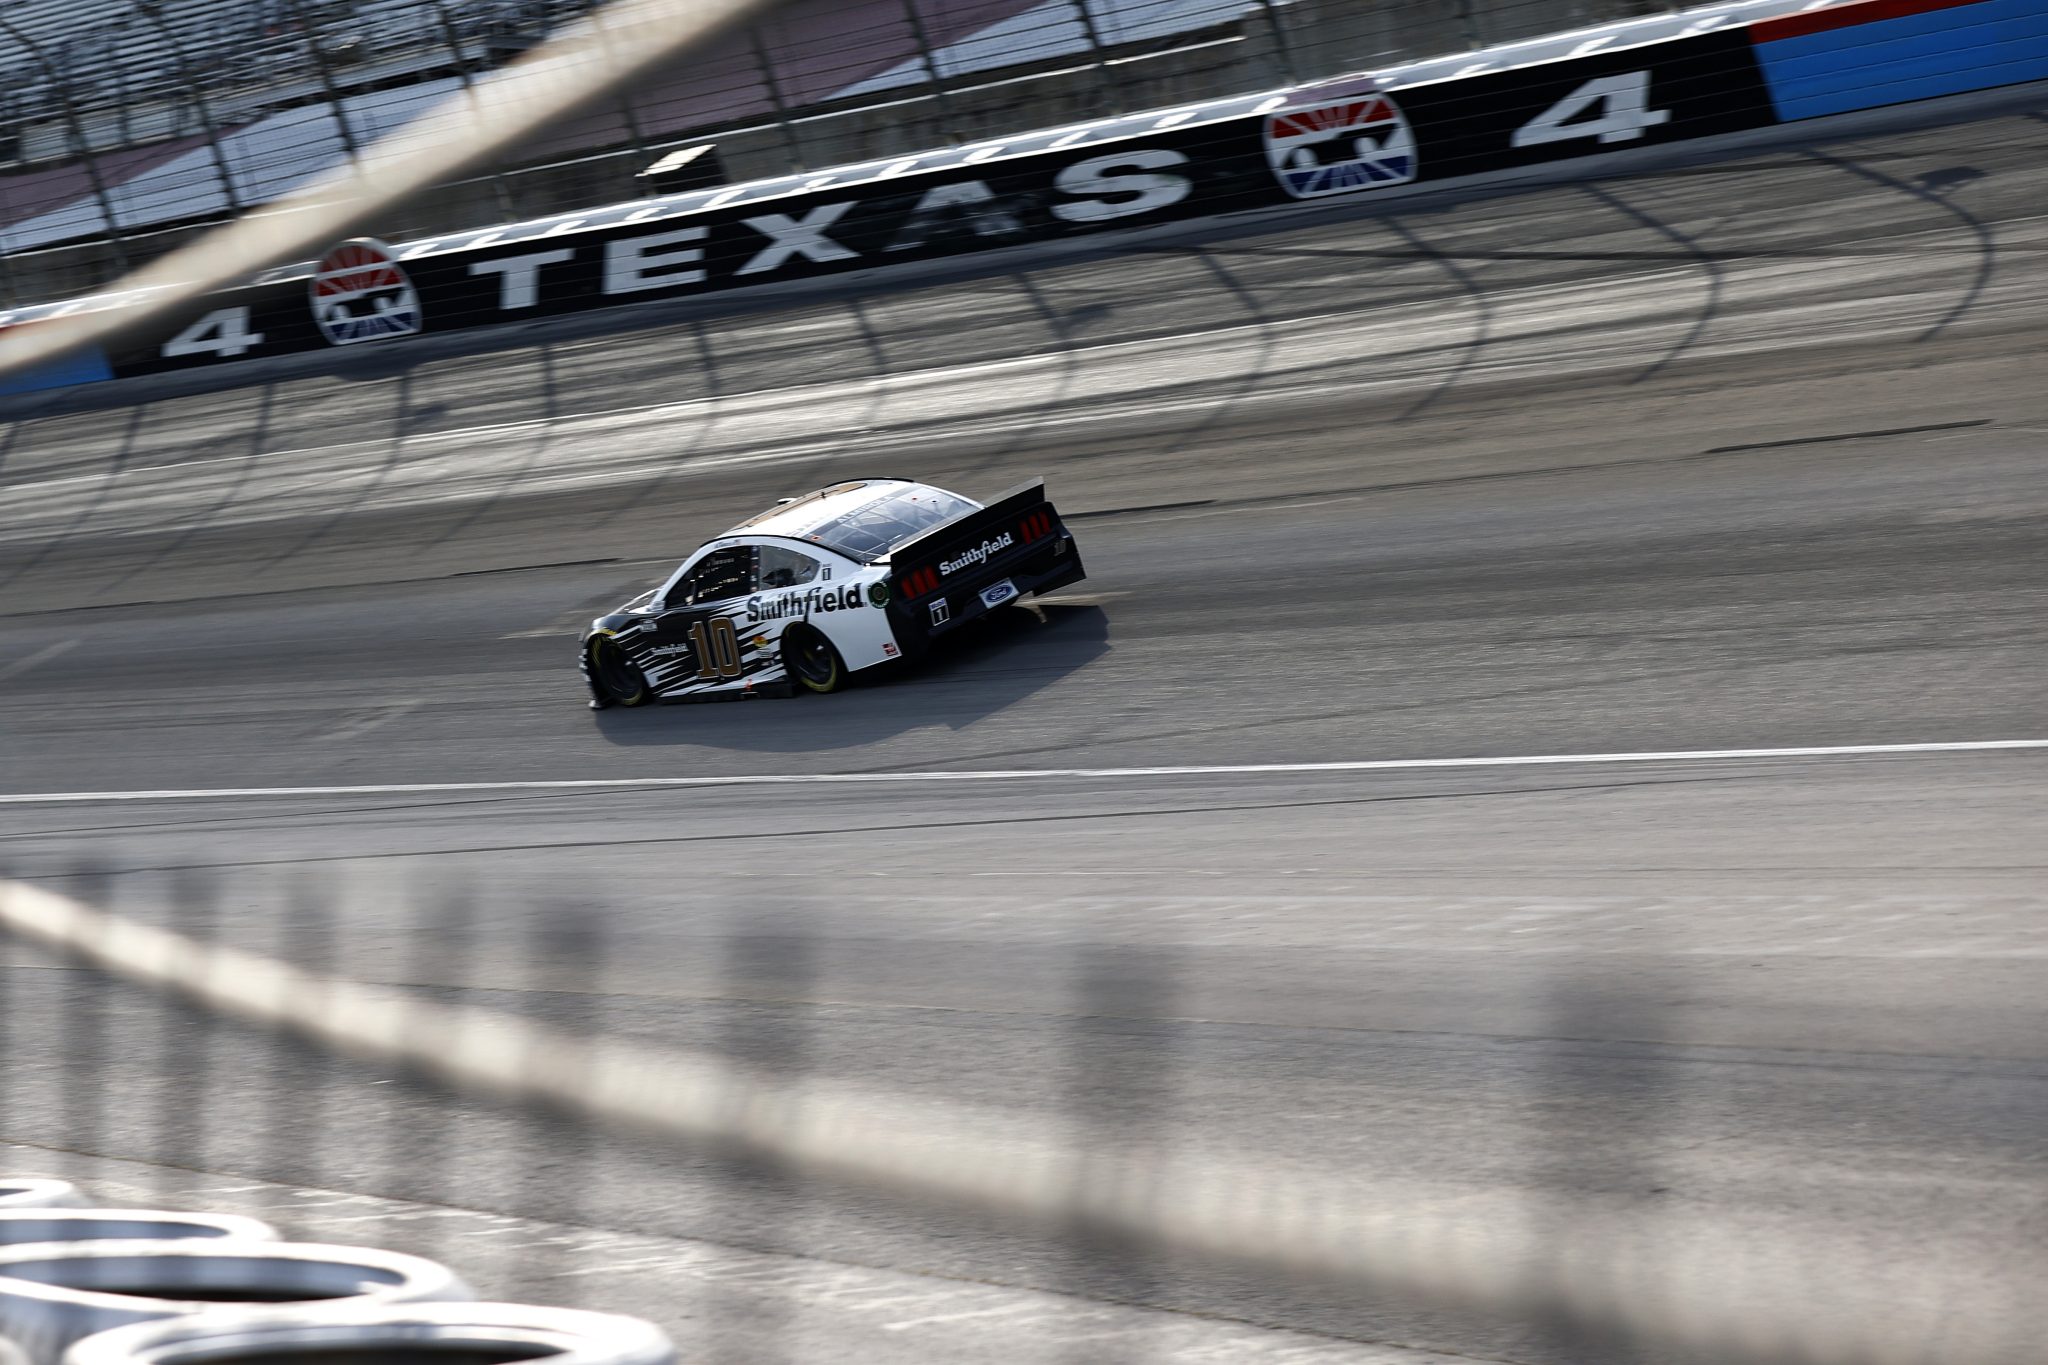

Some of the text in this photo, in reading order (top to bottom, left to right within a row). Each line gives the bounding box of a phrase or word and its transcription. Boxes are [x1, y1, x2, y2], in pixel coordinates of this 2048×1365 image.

[1511, 69, 1672, 148] 4
[469, 149, 1194, 310] TEXAS
[161, 306, 265, 358] 4
[939, 532, 1014, 575] Smithfield
[747, 583, 863, 624] Smithfield
[936, 608, 943, 621] 1
[687, 617, 742, 679] 10
